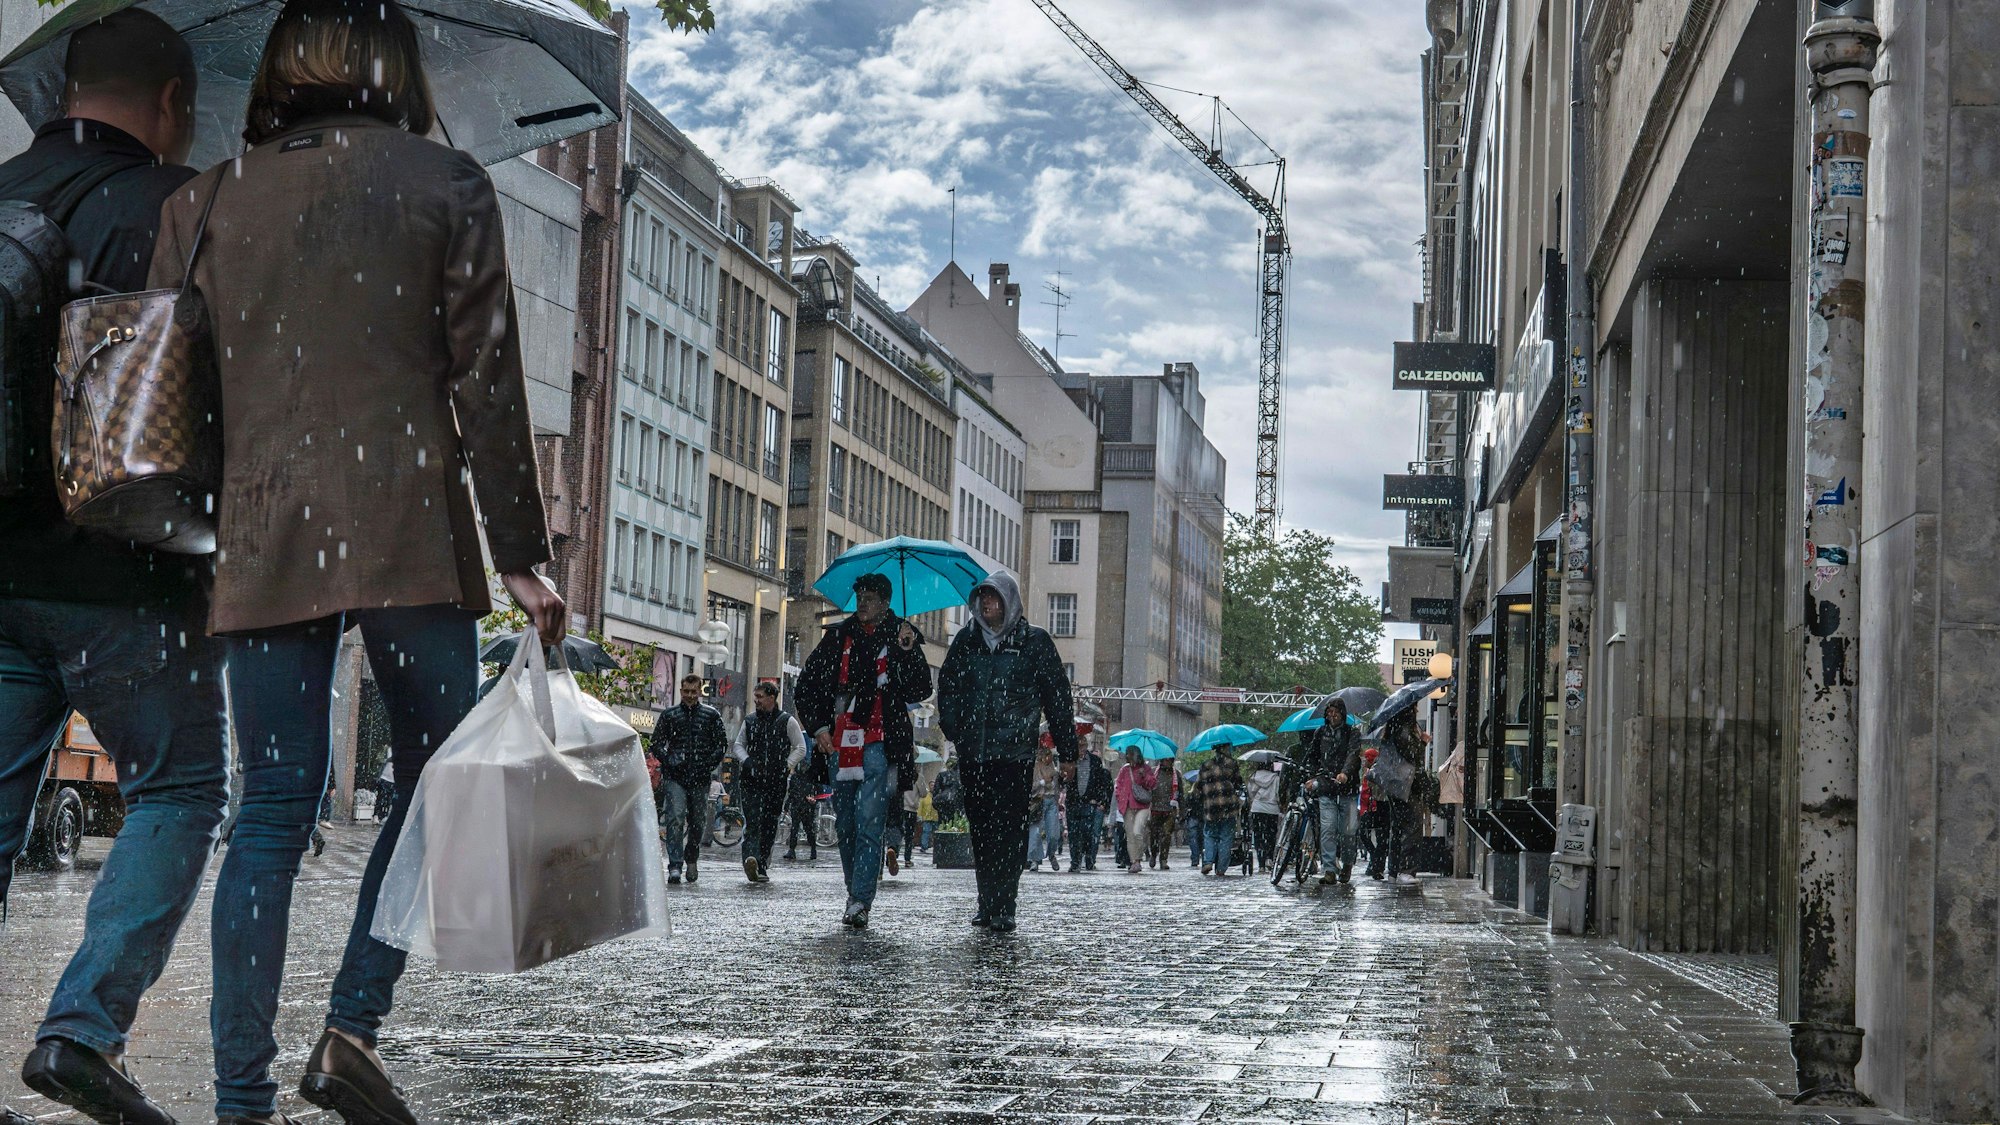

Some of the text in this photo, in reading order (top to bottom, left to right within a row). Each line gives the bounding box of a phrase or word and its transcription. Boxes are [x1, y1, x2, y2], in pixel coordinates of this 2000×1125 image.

[1398, 370, 1485, 382] CALZEDONIA
[1386, 496, 1452, 505] intimissimi
[1402, 647, 1435, 657] LUSH
